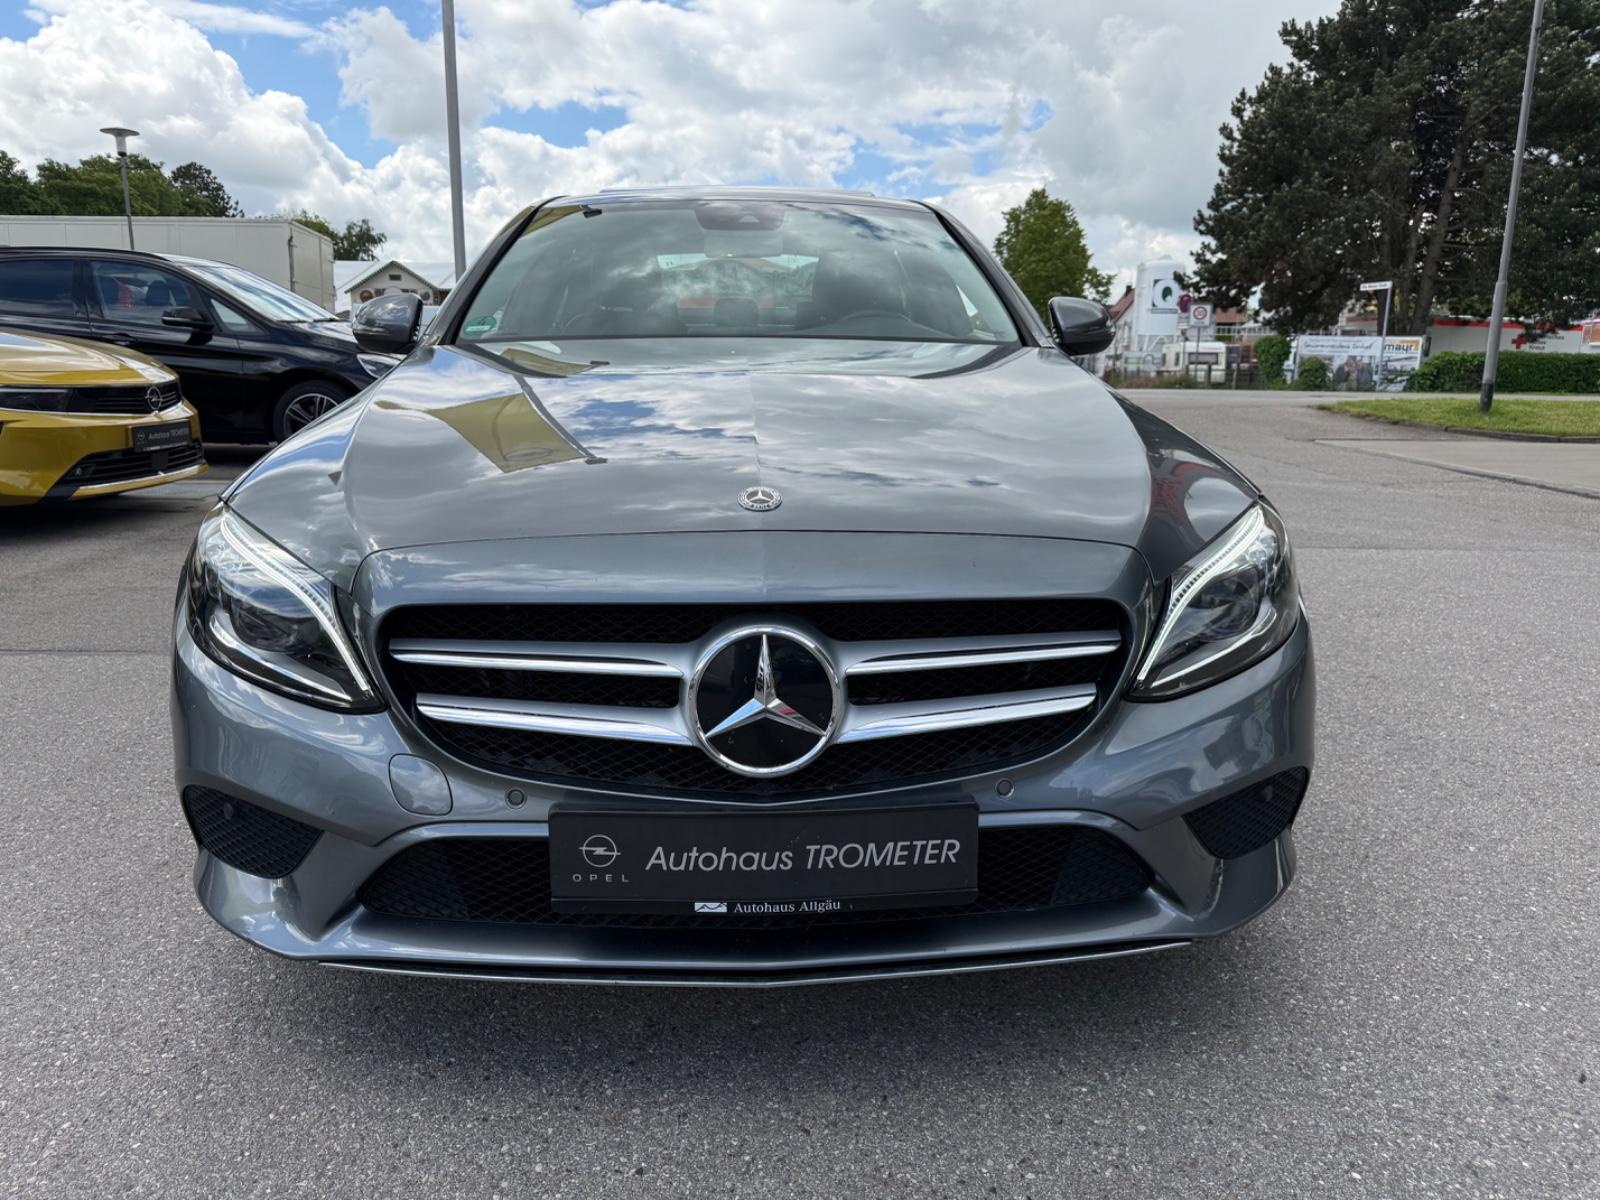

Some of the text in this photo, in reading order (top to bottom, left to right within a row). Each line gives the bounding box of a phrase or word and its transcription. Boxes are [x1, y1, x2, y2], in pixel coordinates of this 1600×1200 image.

[1384, 343, 1414, 354] mayr
[645, 839, 961, 871] Autohaus TROMETER
[572, 873, 630, 883] OPEL
[734, 900, 841, 913] Autohaus Allgäu
